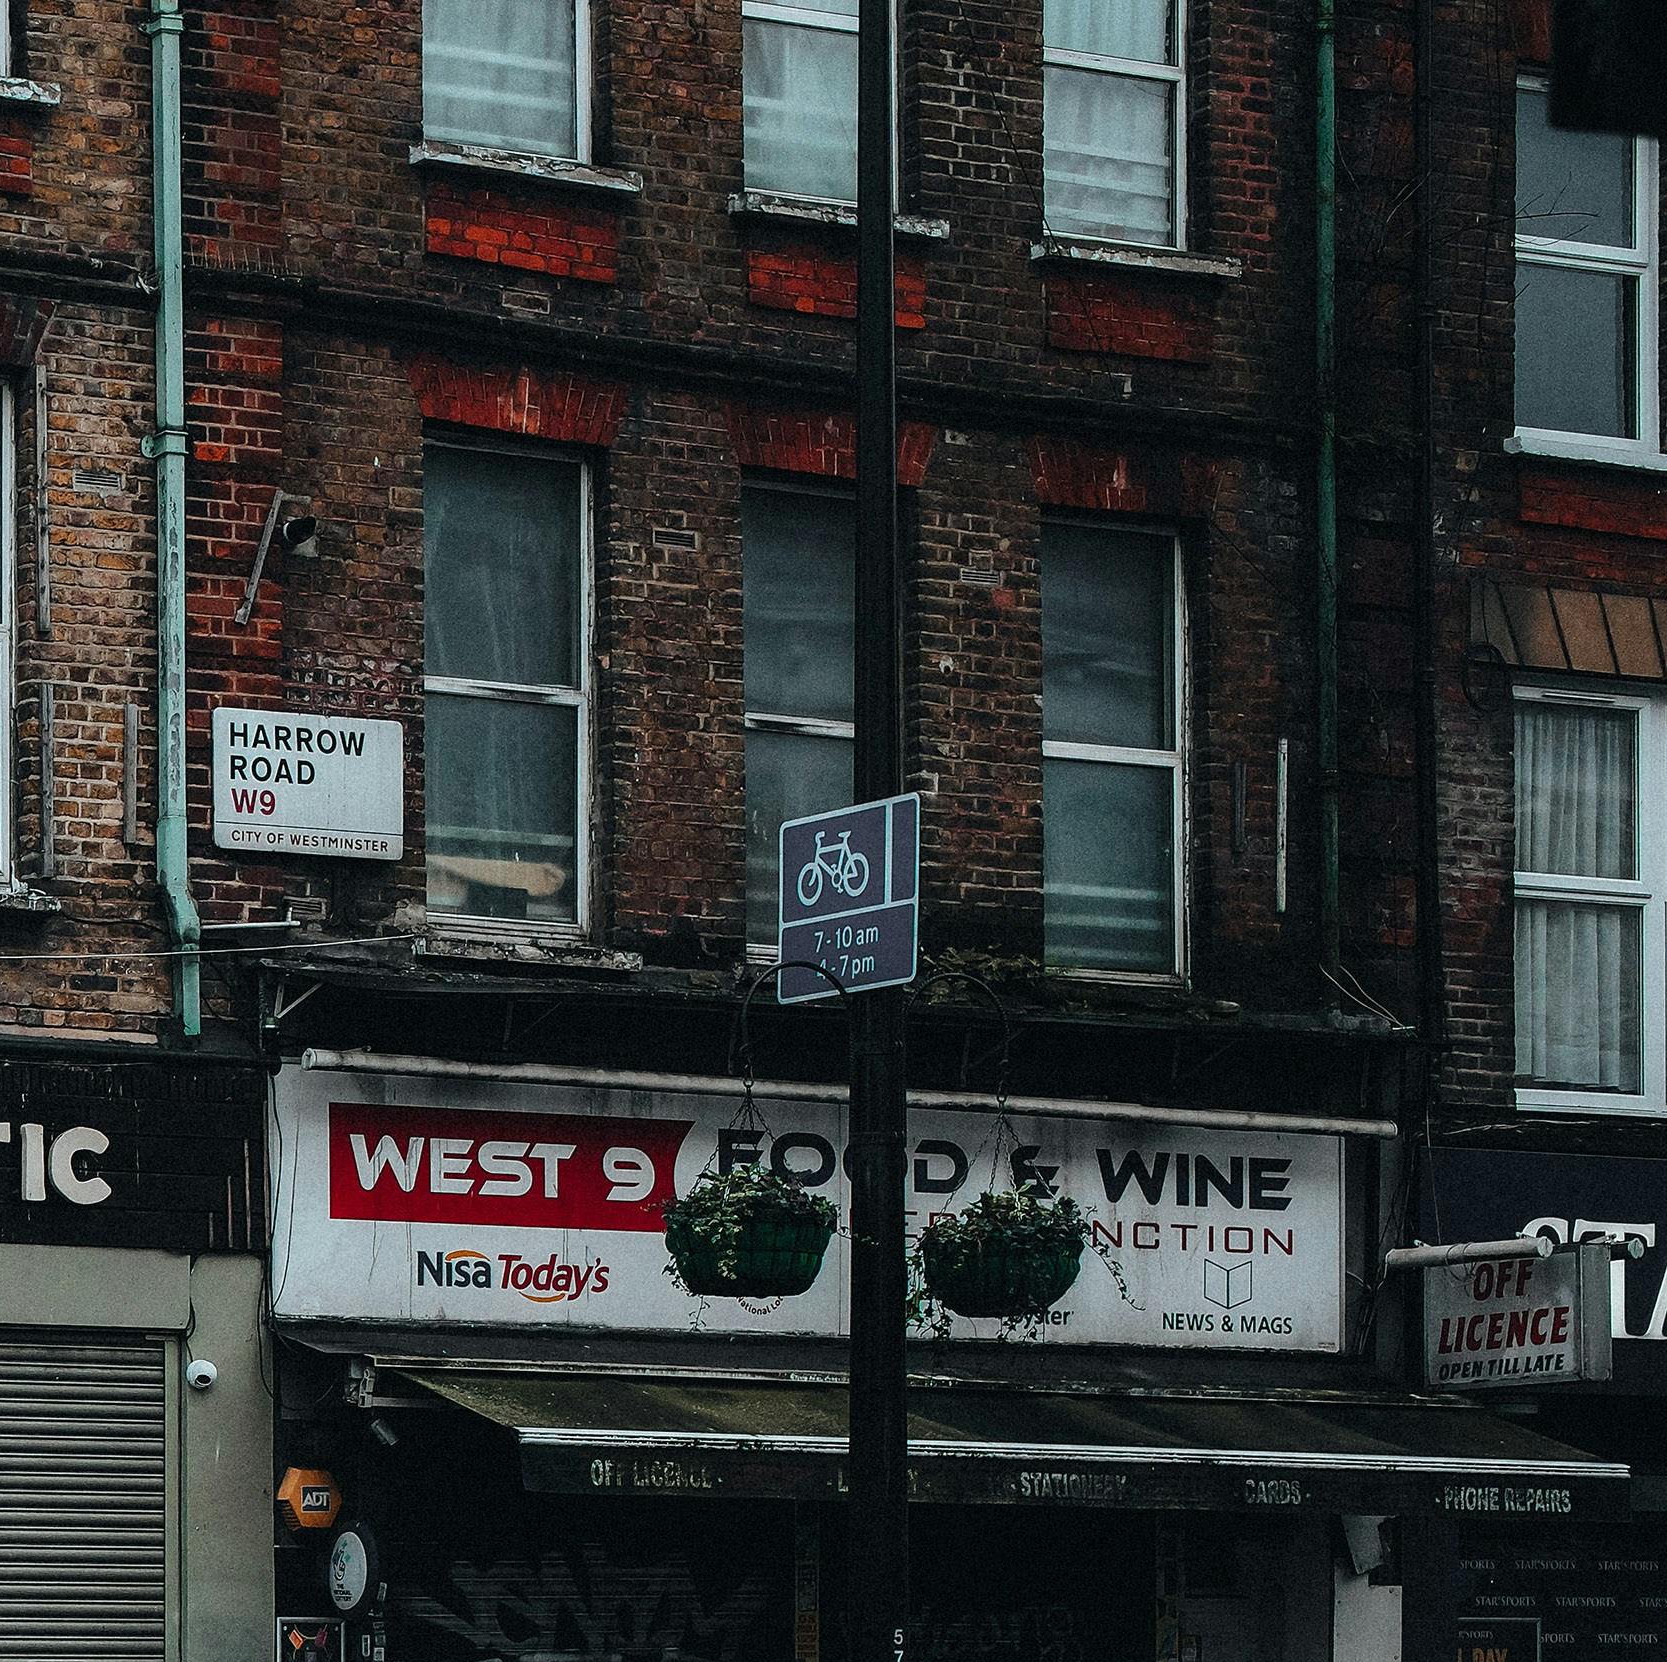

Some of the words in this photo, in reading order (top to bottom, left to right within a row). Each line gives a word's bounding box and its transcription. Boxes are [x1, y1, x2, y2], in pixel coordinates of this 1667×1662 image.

[229, 722, 365, 757] HARROW
[230, 755, 316, 785] ROAD
[231, 788, 276, 815] W9
[231, 830, 262, 844] CITY
[267, 832, 284, 844] OF
[289, 834, 388, 852] WESTMINSTER
[349, 1133, 576, 1199] WEST
[602, 1147, 655, 1202] 9
[717, 1129, 967, 1193] FOD
[1096, 1149, 1292, 1211] WINE
[1092, 1221, 1292, 1256] NCTION
[417, 1251, 492, 1290] Nisa
[498, 1254, 609, 1298] Today's
[1473, 1260, 1534, 1300] OFF
[1162, 1312, 1214, 1332] NEWS
[1221, 1314, 1234, 1332] &
[1240, 1315, 1293, 1335] MAGS
[1438, 1306, 1570, 1354] LICENCE
[1438, 1360, 1484, 1380] OPEN
[1488, 1357, 1520, 1375] TILL
[1525, 1354, 1565, 1372] LATE
[302, 1492, 328, 1507] ADT
[1245, 1480, 1301, 1505] CARDS
[1444, 1485, 1499, 1511] PHONE
[1505, 1487, 1572, 1513] REPAIRS
